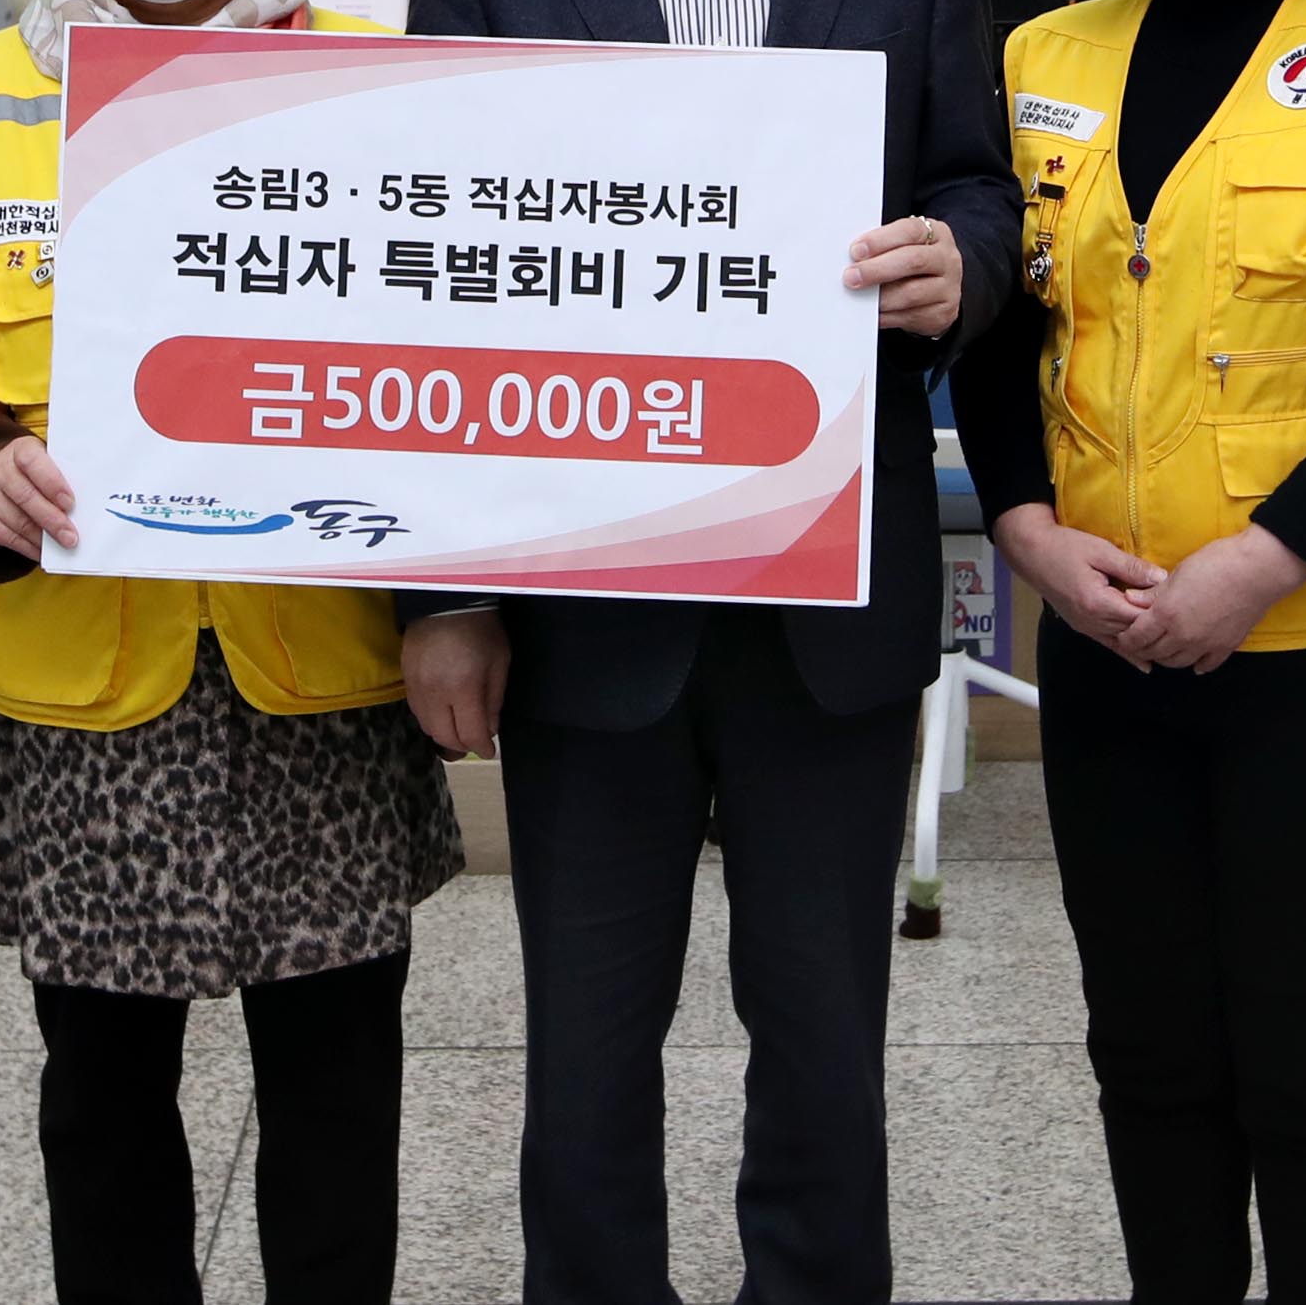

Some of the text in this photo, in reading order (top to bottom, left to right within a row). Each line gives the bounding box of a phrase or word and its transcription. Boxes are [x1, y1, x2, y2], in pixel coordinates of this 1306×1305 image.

[468, 176, 738, 229] 적십자봉사회
[173, 232, 777, 315] 적십자 특별회비 기탁
[242, 362, 704, 455] 금500,000원
[290, 499, 412, 548] 동구
